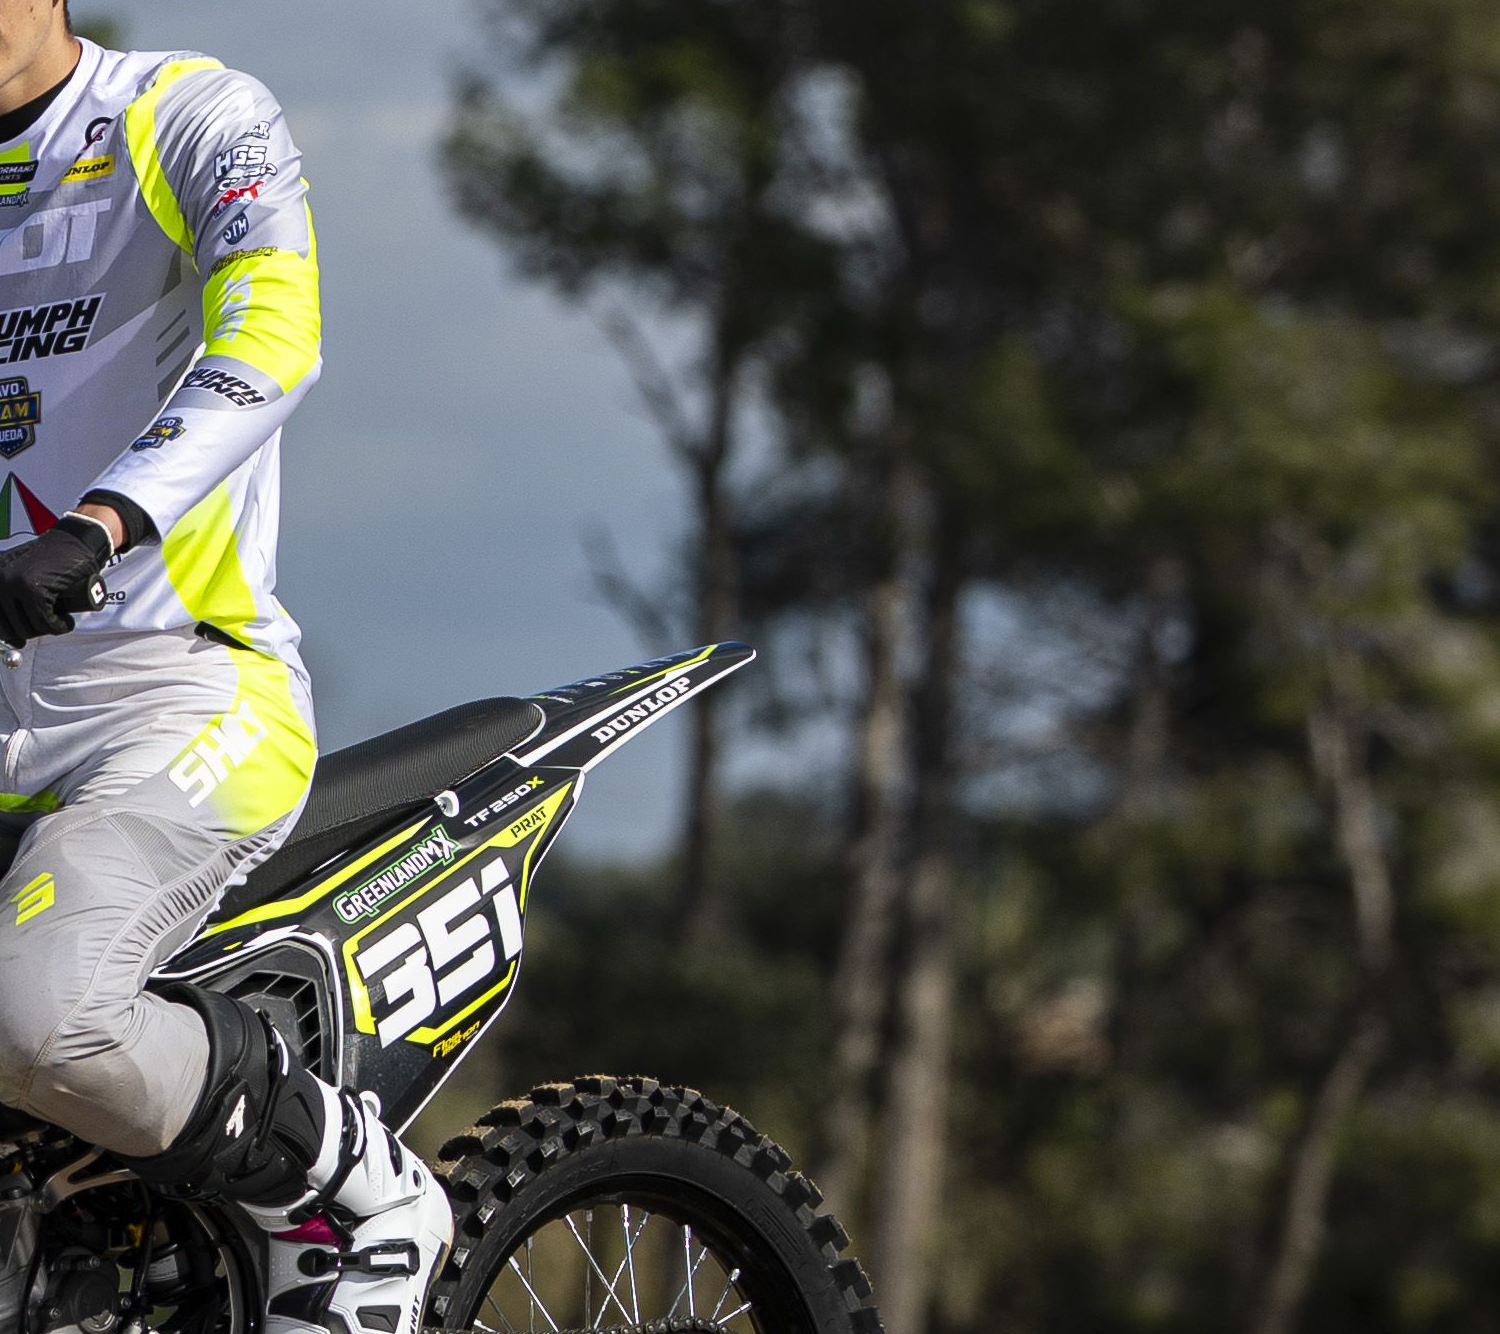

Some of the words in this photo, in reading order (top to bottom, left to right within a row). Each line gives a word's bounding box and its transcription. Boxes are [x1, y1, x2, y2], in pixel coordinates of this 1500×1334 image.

[215, 146, 267, 178] HGS
[591, 676, 691, 744] DUNLOP
[464, 775, 545, 827] TF250X
[510, 806, 548, 839] PRAT
[336, 828, 457, 921] GREENLANDMX
[356, 856, 523, 1049] 351
